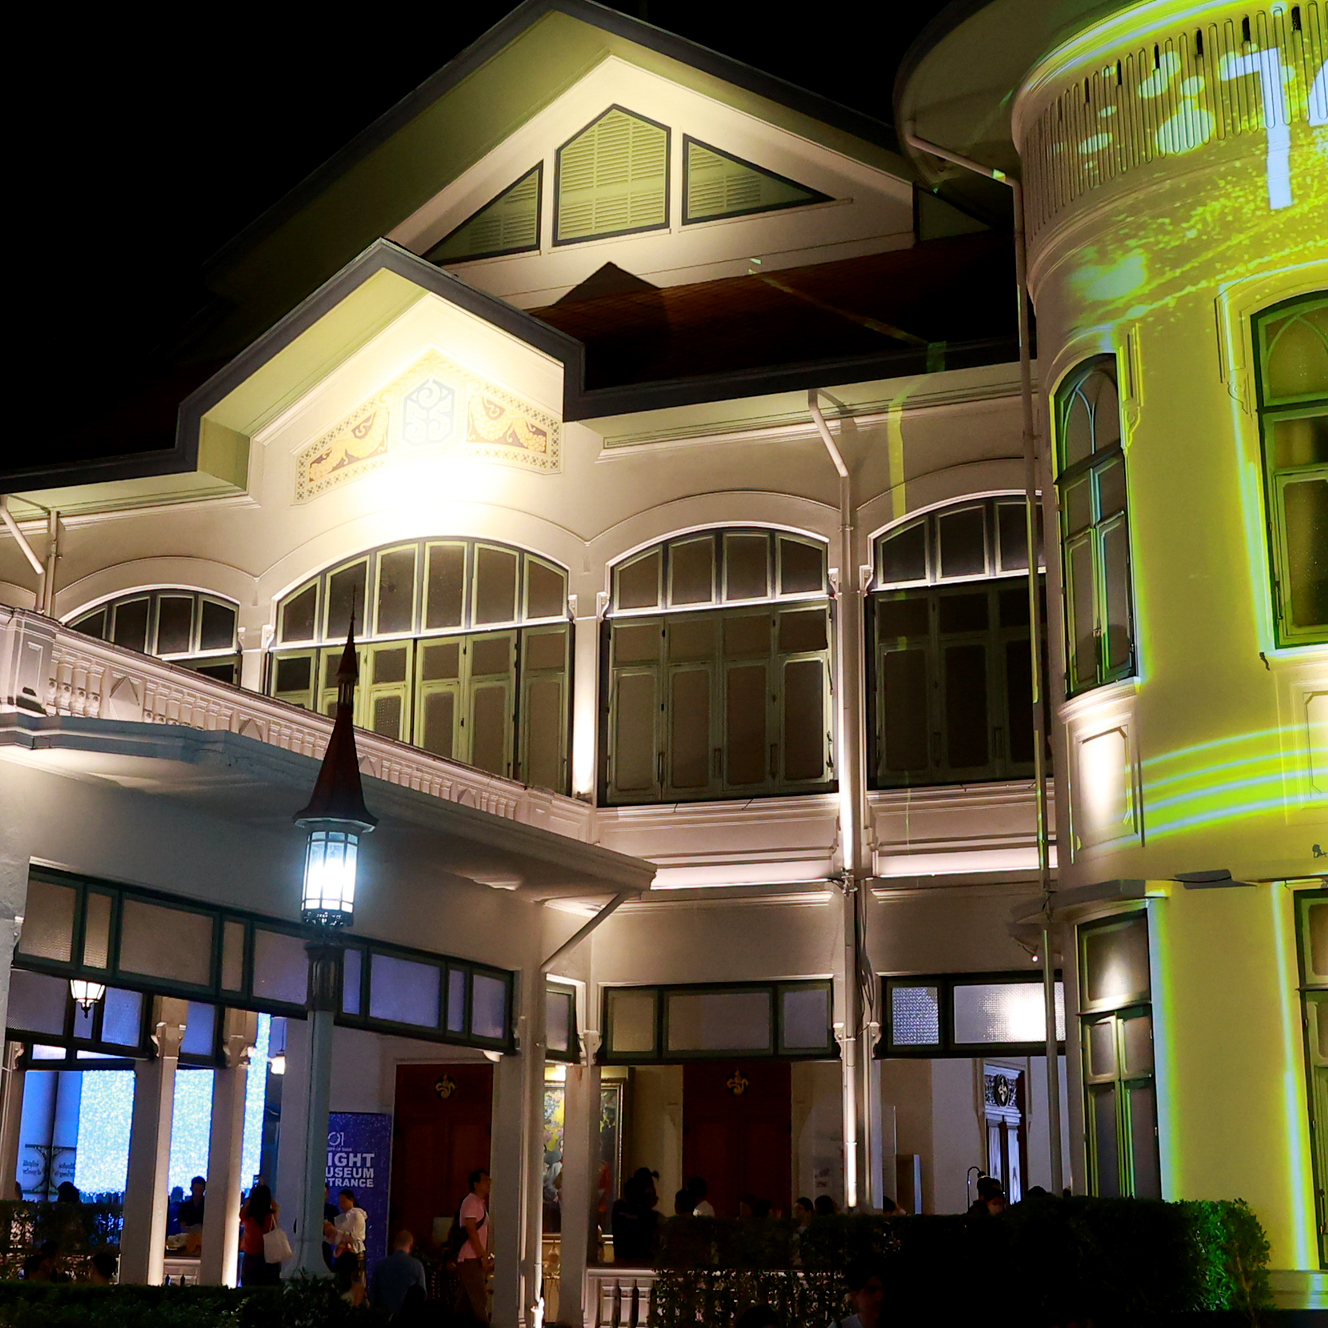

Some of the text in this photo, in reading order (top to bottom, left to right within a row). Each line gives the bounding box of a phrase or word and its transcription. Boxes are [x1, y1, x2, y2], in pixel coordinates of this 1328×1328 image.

[327, 1132, 345, 1146] 01
[327, 1152, 375, 1167] IGHT
[325, 1166, 374, 1179] USEUM
[325, 1177, 374, 1188] TRANCE
